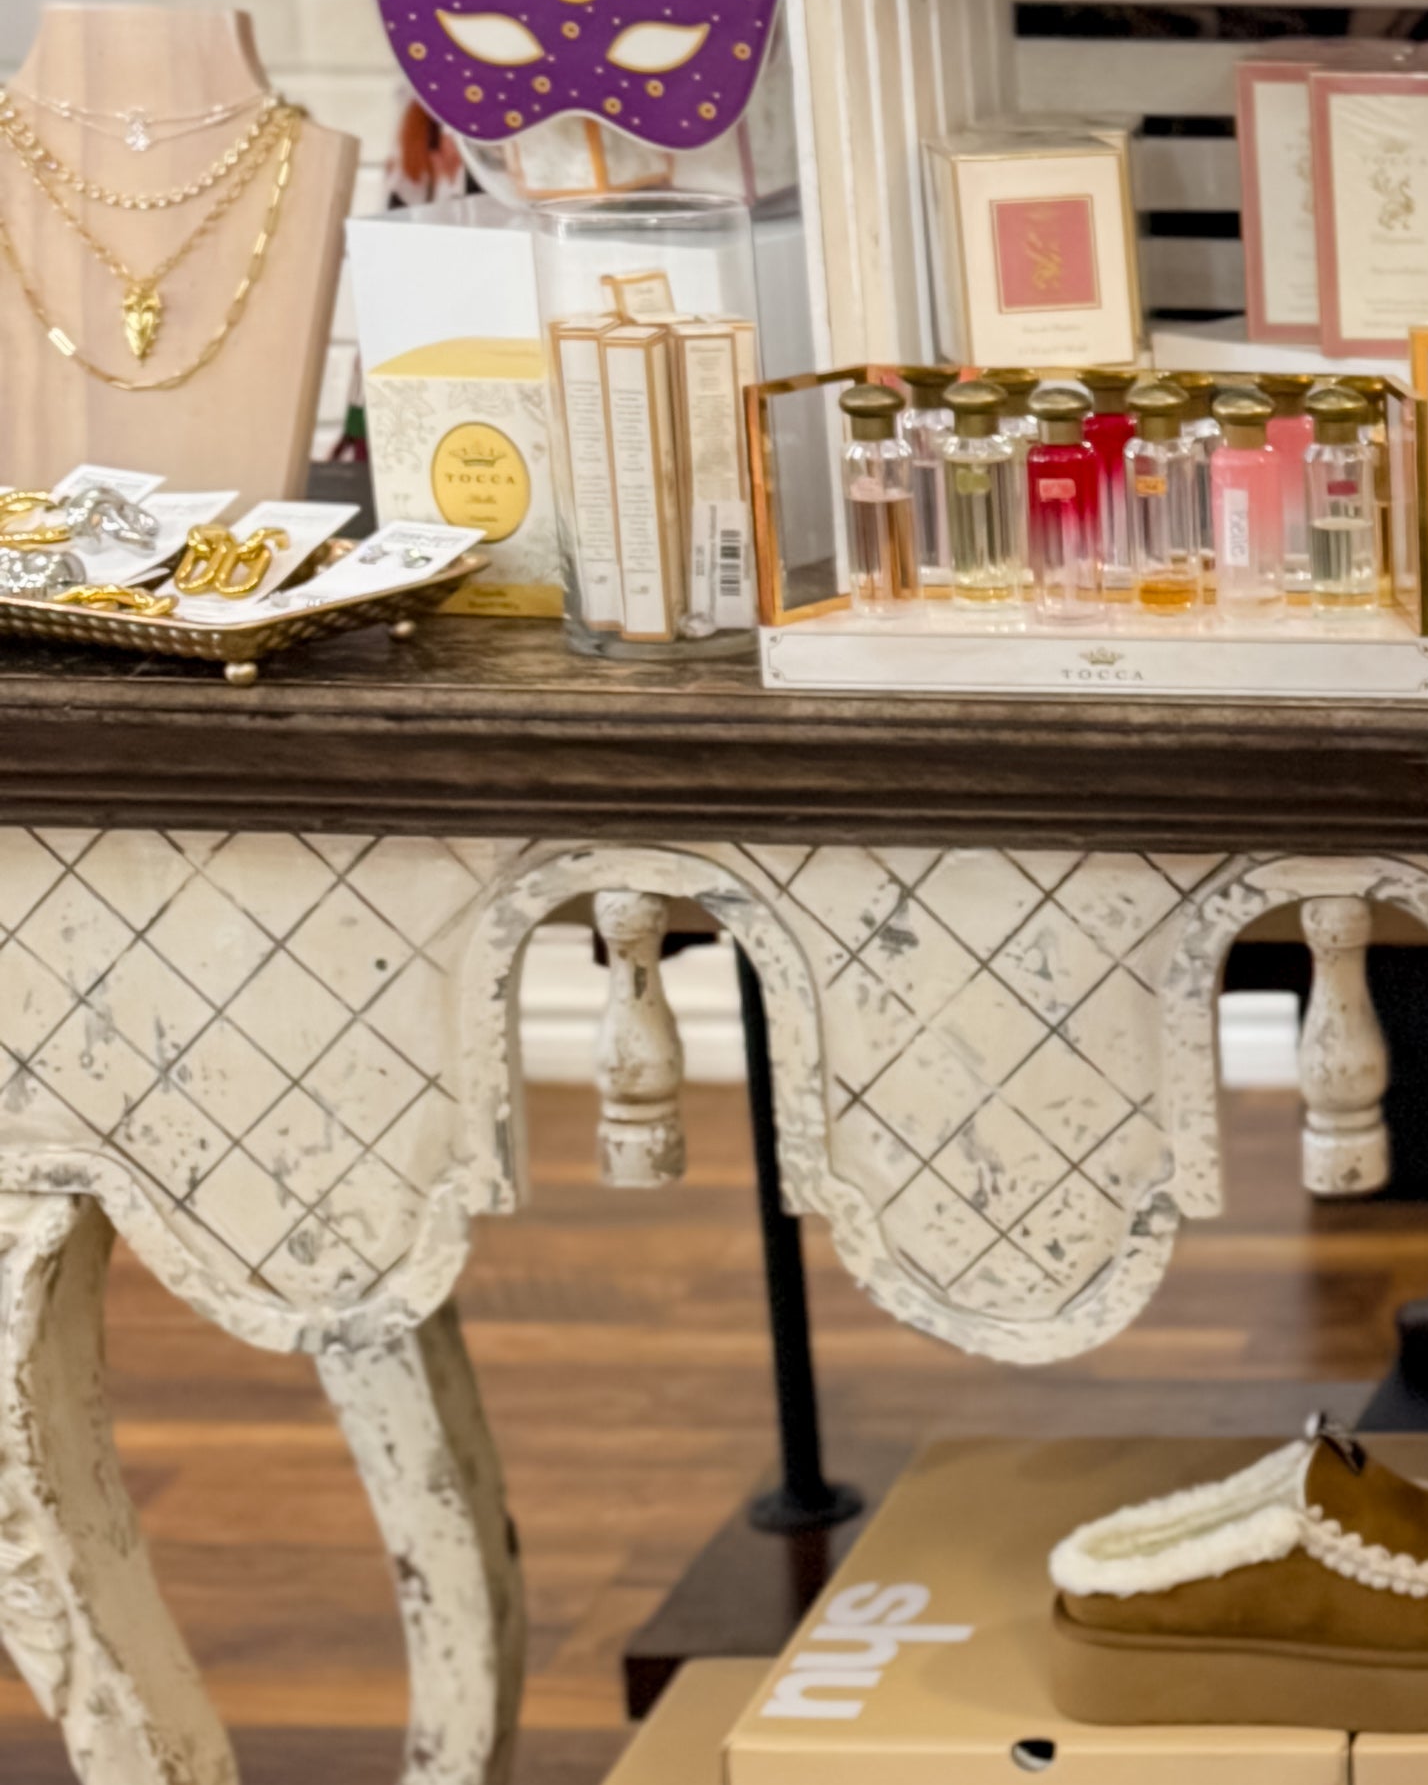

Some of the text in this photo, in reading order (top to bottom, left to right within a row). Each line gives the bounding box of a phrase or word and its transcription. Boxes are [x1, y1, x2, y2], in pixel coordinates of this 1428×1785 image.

[444, 472, 517, 486] TOCCA
[1061, 668, 1145, 681] TOCCA
[760, 1581, 977, 1720] shu
